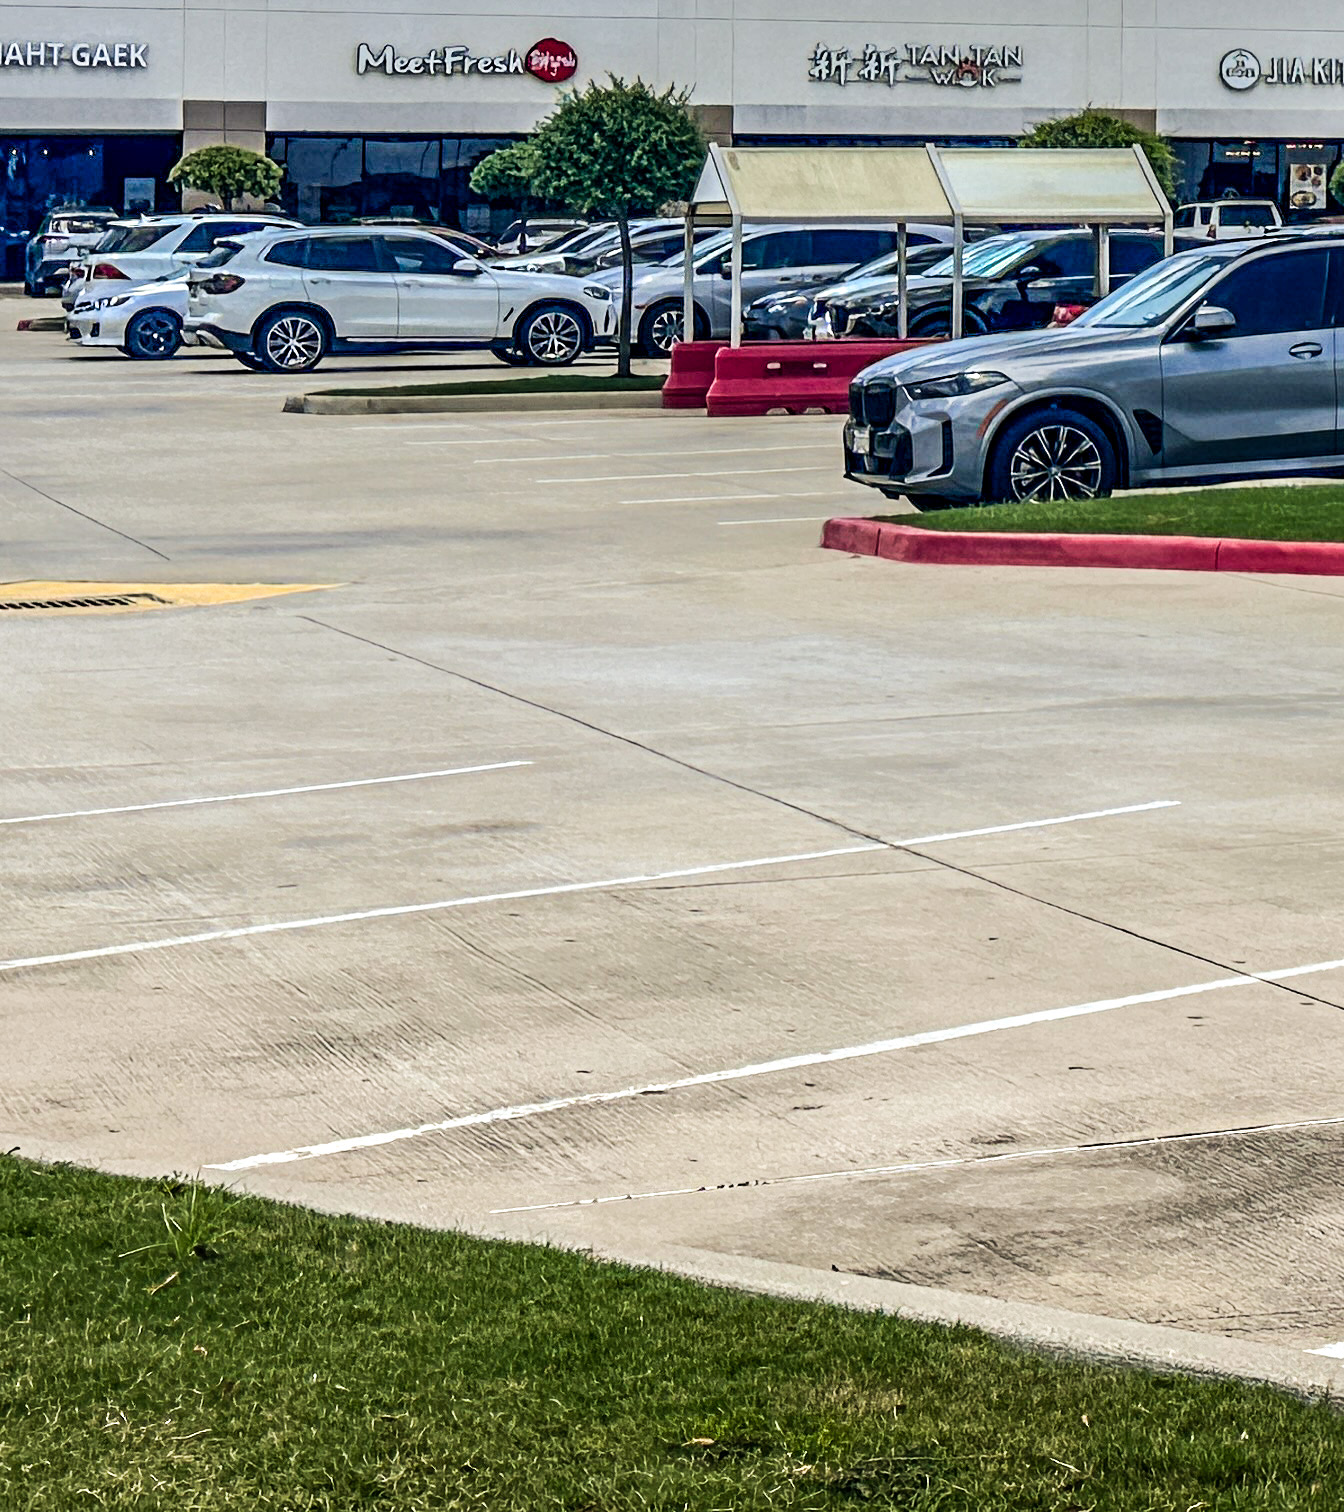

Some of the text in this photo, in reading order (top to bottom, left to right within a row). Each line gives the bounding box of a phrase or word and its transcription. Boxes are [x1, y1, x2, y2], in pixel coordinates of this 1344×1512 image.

[0, 41, 148, 68] AHT GAEK
[905, 42, 1023, 66] TAN TAN
[1265, 56, 1305, 85] JIA
